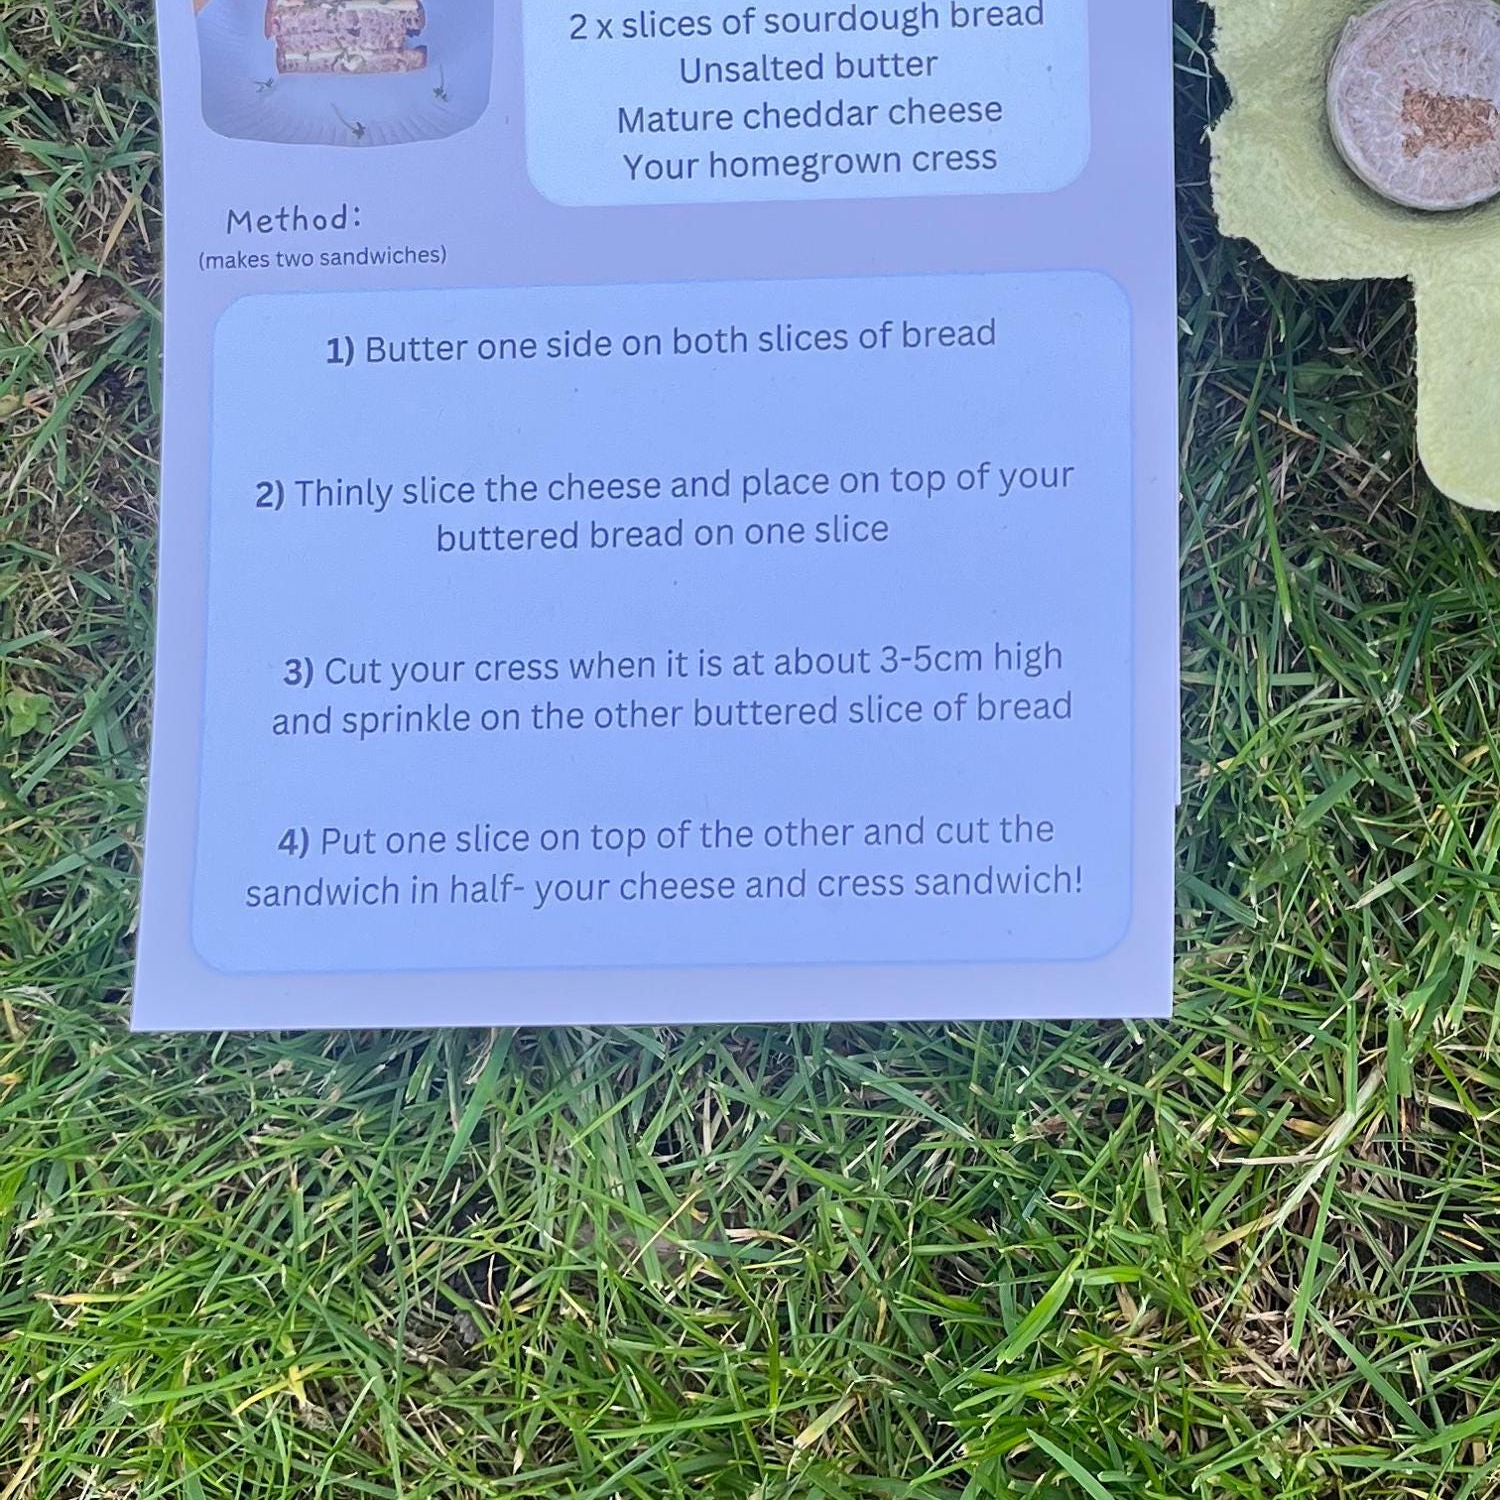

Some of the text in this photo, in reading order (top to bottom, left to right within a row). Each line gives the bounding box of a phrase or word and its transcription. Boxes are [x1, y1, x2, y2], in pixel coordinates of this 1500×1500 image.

[571, 14, 587, 39] 2
[597, 19, 613, 39] x
[623, 10, 711, 38] slices
[723, 7, 756, 35] of
[765, 2, 938, 37] sourdough
[681, 52, 938, 83] Unsalted butter
[619, 97, 1002, 133] Mature cheddar cheese
[624, 150, 996, 182] Your homegrown cress
[227, 203, 359, 234] Method:
[200, 245, 446, 271] (makes two sandwiches)
[327, 318, 995, 366] 1) Butter one side on both slices of bread
[257, 462, 1074, 512] 2) Thinly slice the cheese and place on top of your
[438, 514, 888, 551] buttered bread on one slice
[284, 641, 1061, 691] 3) Cut your cress when it is at about 3-5cm high
[273, 691, 1071, 740] and sprinkle on the other buttered slice of bread
[278, 814, 1053, 859] 4) Put one slice on top of the other and cut the
[247, 864, 1080, 909] sandwich in half- your cheese and cress sandwich!
